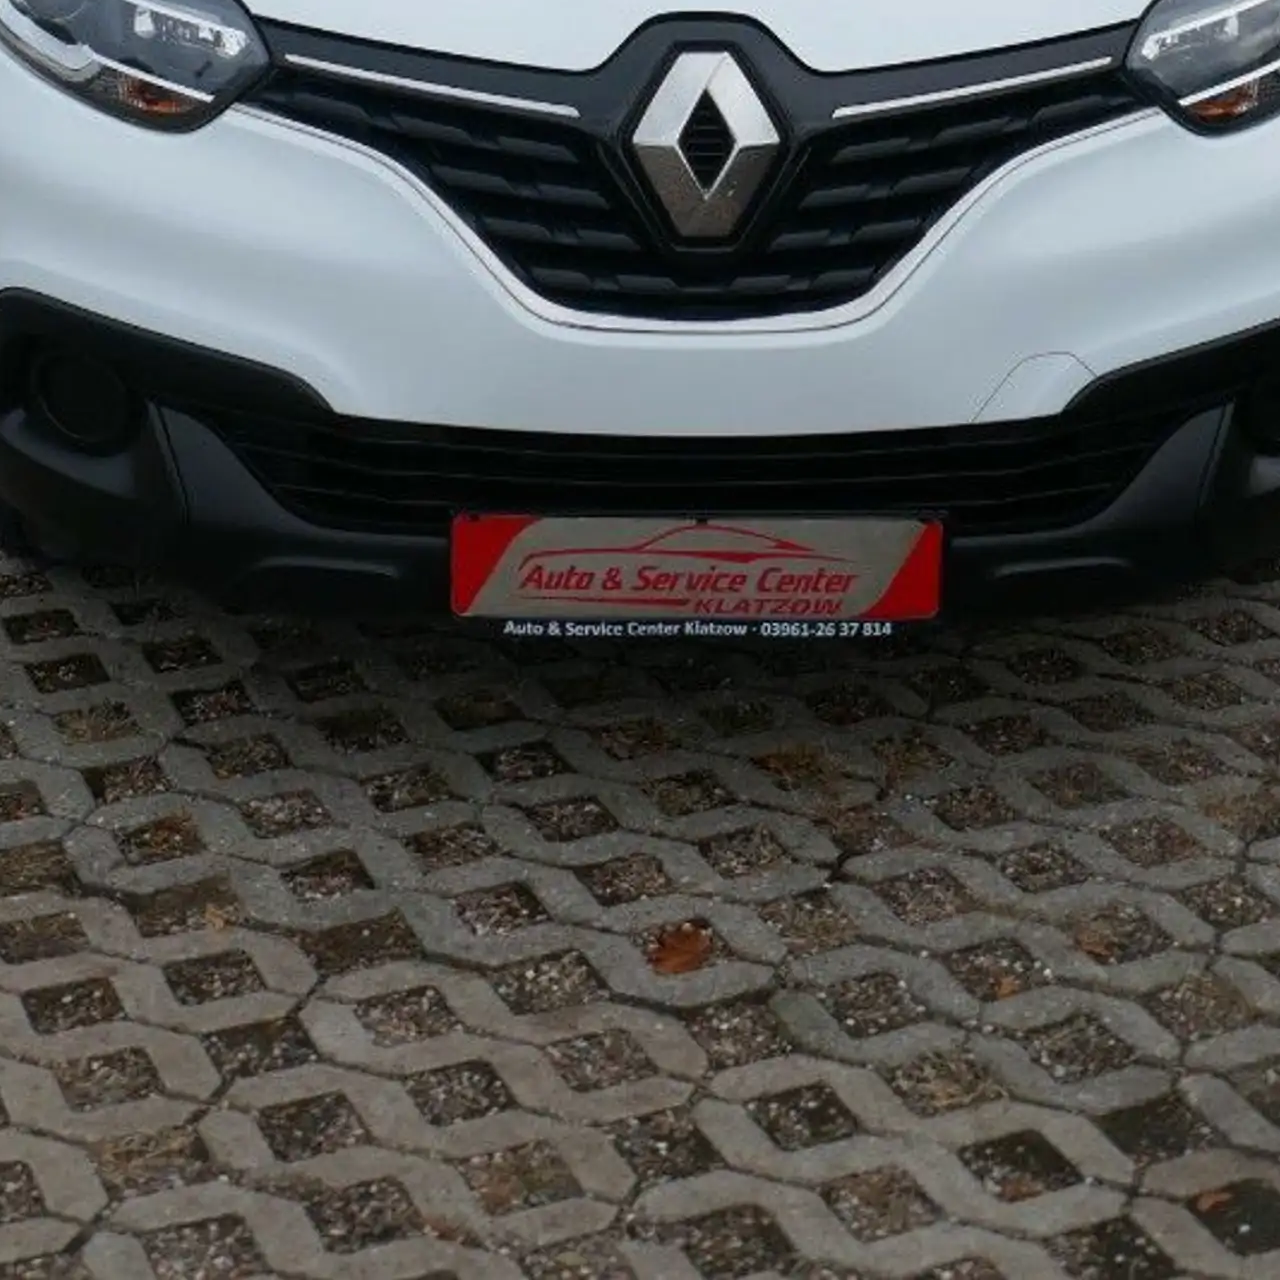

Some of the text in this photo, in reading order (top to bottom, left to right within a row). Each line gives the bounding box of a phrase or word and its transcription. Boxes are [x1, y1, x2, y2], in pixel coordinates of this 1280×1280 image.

[519, 565, 861, 595] Auto & Service Center
[693, 597, 846, 616] KLATZOW
[504, 620, 544, 636] Auto
[546, 620, 562, 636] &
[564, 620, 622, 637] Service
[627, 621, 681, 637] Center
[684, 621, 748, 637] Klatzow
